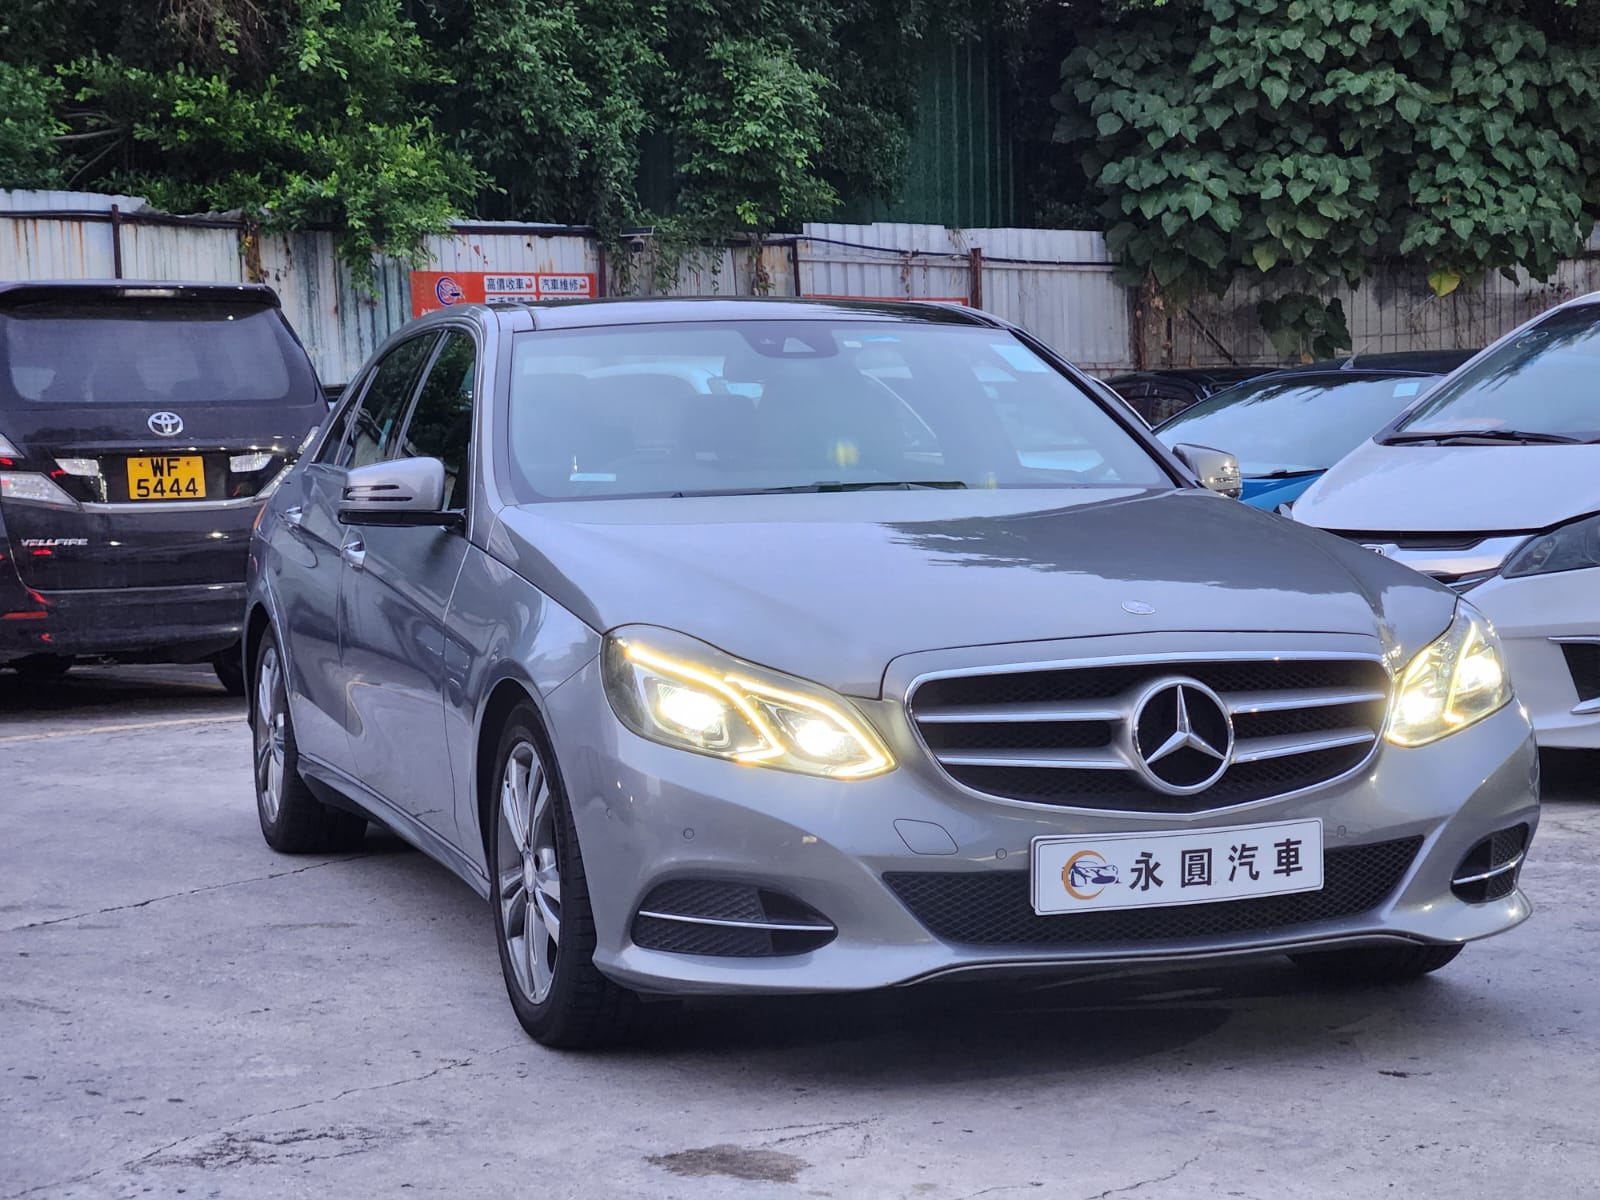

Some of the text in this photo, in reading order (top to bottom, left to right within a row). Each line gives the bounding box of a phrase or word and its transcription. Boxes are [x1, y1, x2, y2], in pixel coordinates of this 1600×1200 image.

[541, 278, 578, 291] 汽車維修
[150, 457, 180, 477] WF
[136, 477, 198, 497] 5444
[20, 538, 89, 547] VELLFIRE
[1129, 838, 1303, 892] 永圓汽車
